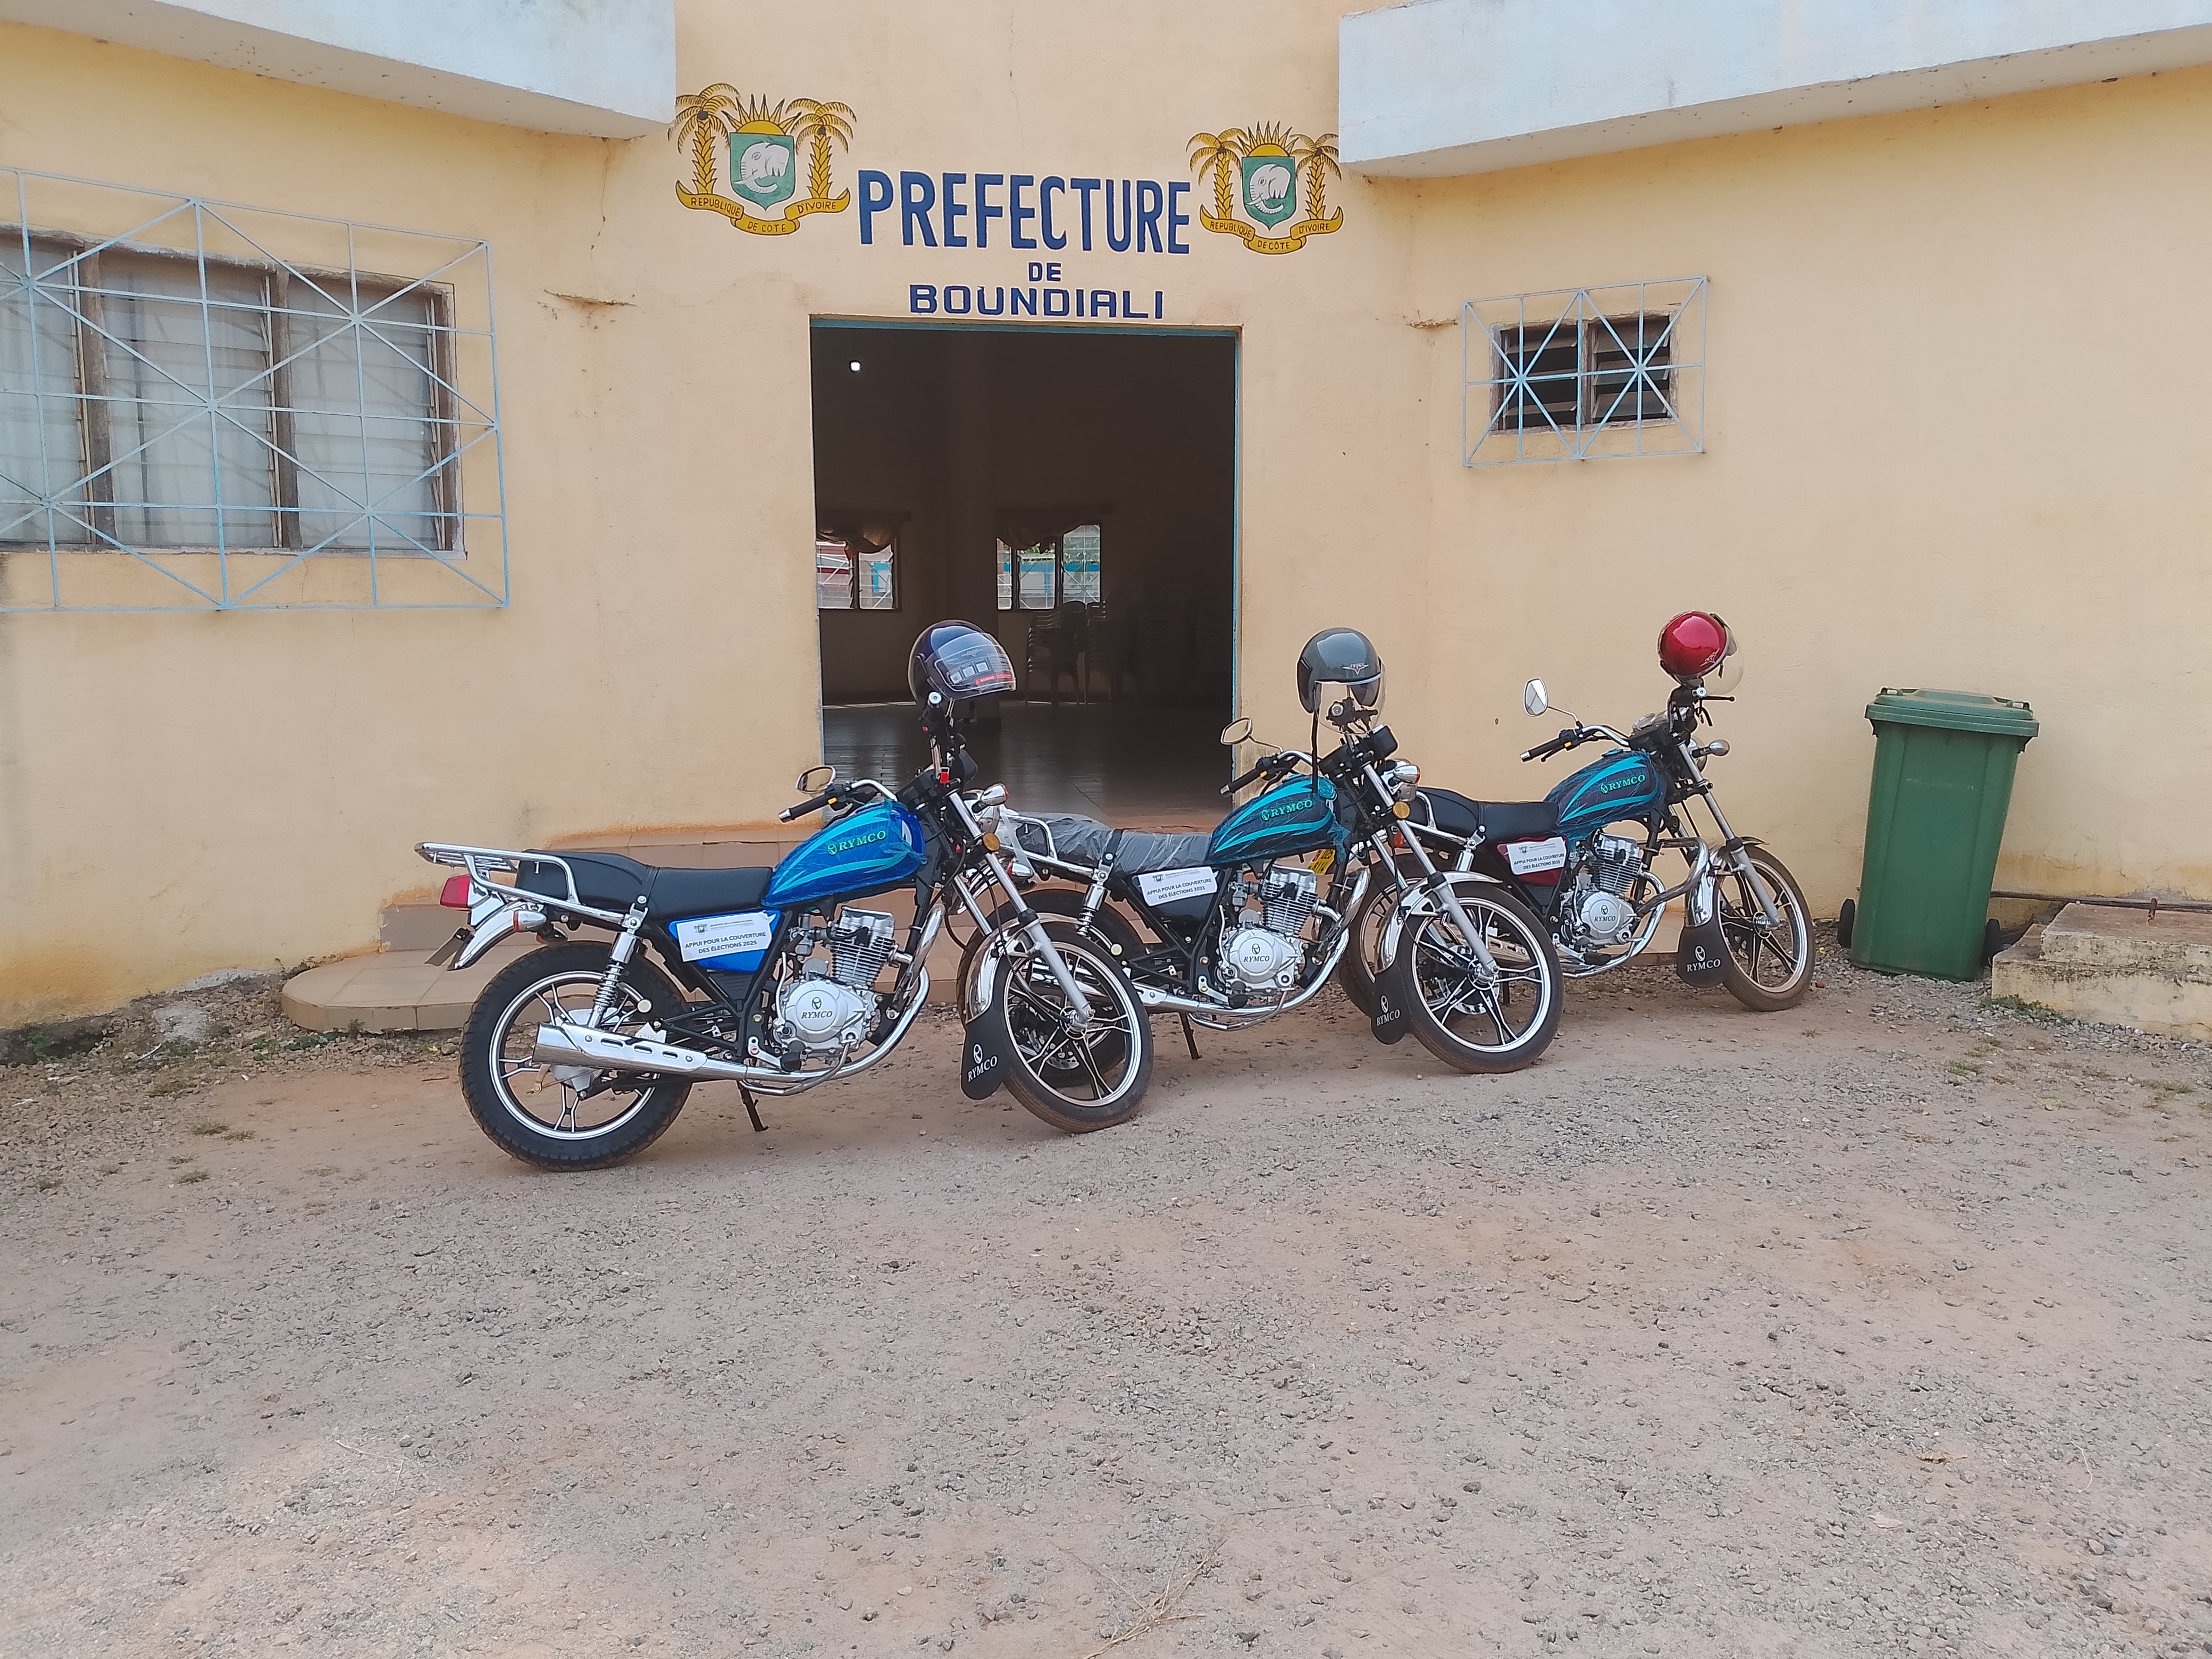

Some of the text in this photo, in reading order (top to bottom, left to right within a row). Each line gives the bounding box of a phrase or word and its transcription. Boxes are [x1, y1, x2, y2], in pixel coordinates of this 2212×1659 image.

[691, 197, 741, 217] REPUBLIQUE
[798, 200, 836, 213] D'IVOIRE
[858, 170, 1191, 254] PREFECTURE
[747, 221, 758, 231] DE
[1210, 221, 1253, 237] REPUBLIQUE
[1299, 223, 1330, 234] D'IVOIRE
[1258, 240, 1291, 250] DE CÔTE
[1028, 262, 1062, 282] DE
[909, 284, 1164, 320] BOUNDIALI
[1608, 775, 1645, 791] RYMCO
[1271, 800, 1312, 817] RYMCO
[839, 831, 886, 851] RYMCO
[1182, 878, 1212, 887] COUVERTURE
[1168, 888, 1194, 897] ÉLECTIONS
[729, 932, 767, 941] COUVERTURE
[711, 942, 742, 952] ÉLECTIONS
[1686, 959, 1721, 973] RYMCO
[801, 1011, 833, 1019] RYMCO
[1376, 1009, 1401, 1027] RYMCO
[967, 1055, 998, 1083] RYMCO
